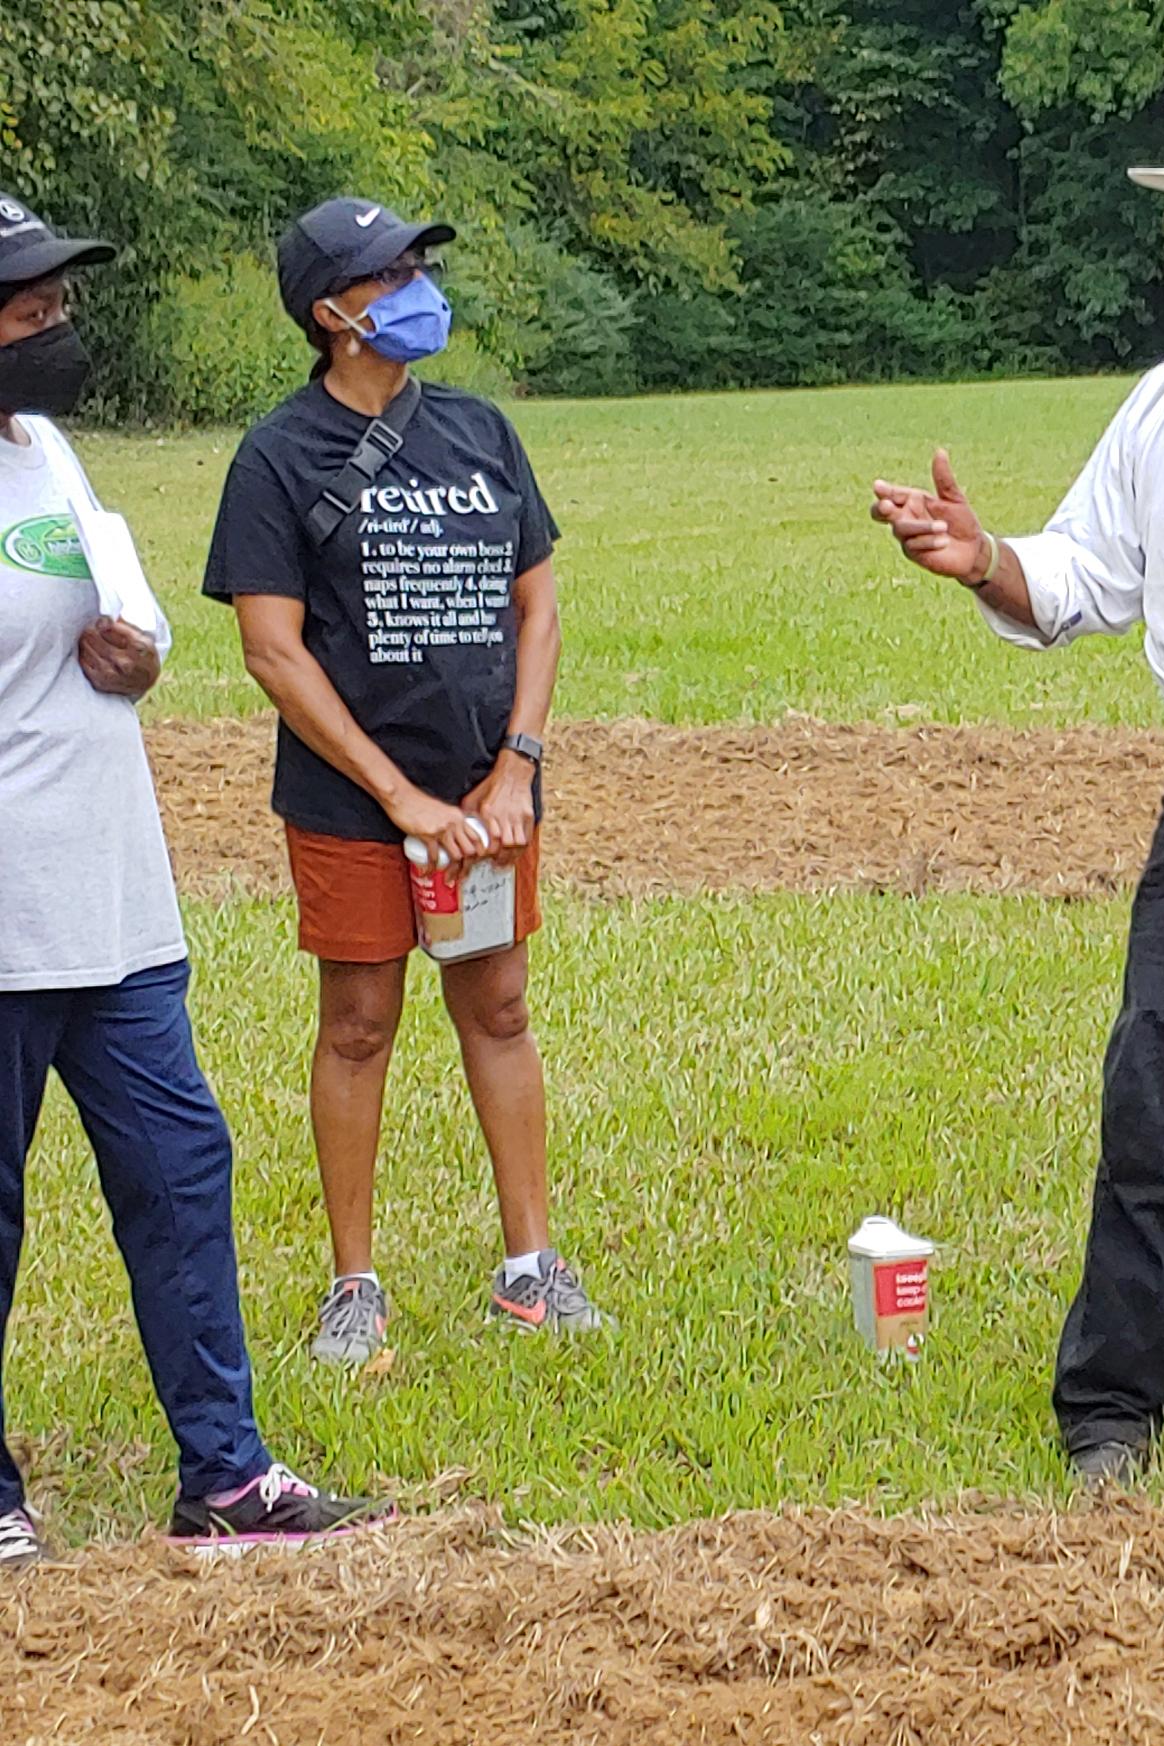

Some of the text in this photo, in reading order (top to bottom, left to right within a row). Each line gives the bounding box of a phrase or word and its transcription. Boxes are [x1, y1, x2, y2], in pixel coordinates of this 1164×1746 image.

[360, 471, 499, 515] retired
[379, 542, 396, 556] to
[397, 540, 416, 556] be
[417, 545, 448, 561] your
[450, 545, 476, 556] own
[362, 558, 420, 577] requires
[423, 562, 441, 574] no
[443, 558, 475, 574] alarm
[363, 579, 397, 596] naps
[400, 575, 462, 596] frequently
[364, 594, 399, 609] what
[401, 593, 408, 609] I
[446, 592, 476, 608] when
[478, 592, 484, 608] I
[367, 612, 384, 627] 5.
[385, 612, 430, 627] knows
[431, 612, 441, 627] it
[442, 611, 457, 626] all
[458, 610, 480, 626] and
[369, 631, 413, 649] plenty
[413, 629, 429, 645] of
[430, 630, 457, 645] time
[458, 631, 472, 643] to
[369, 648, 423, 663] about it
